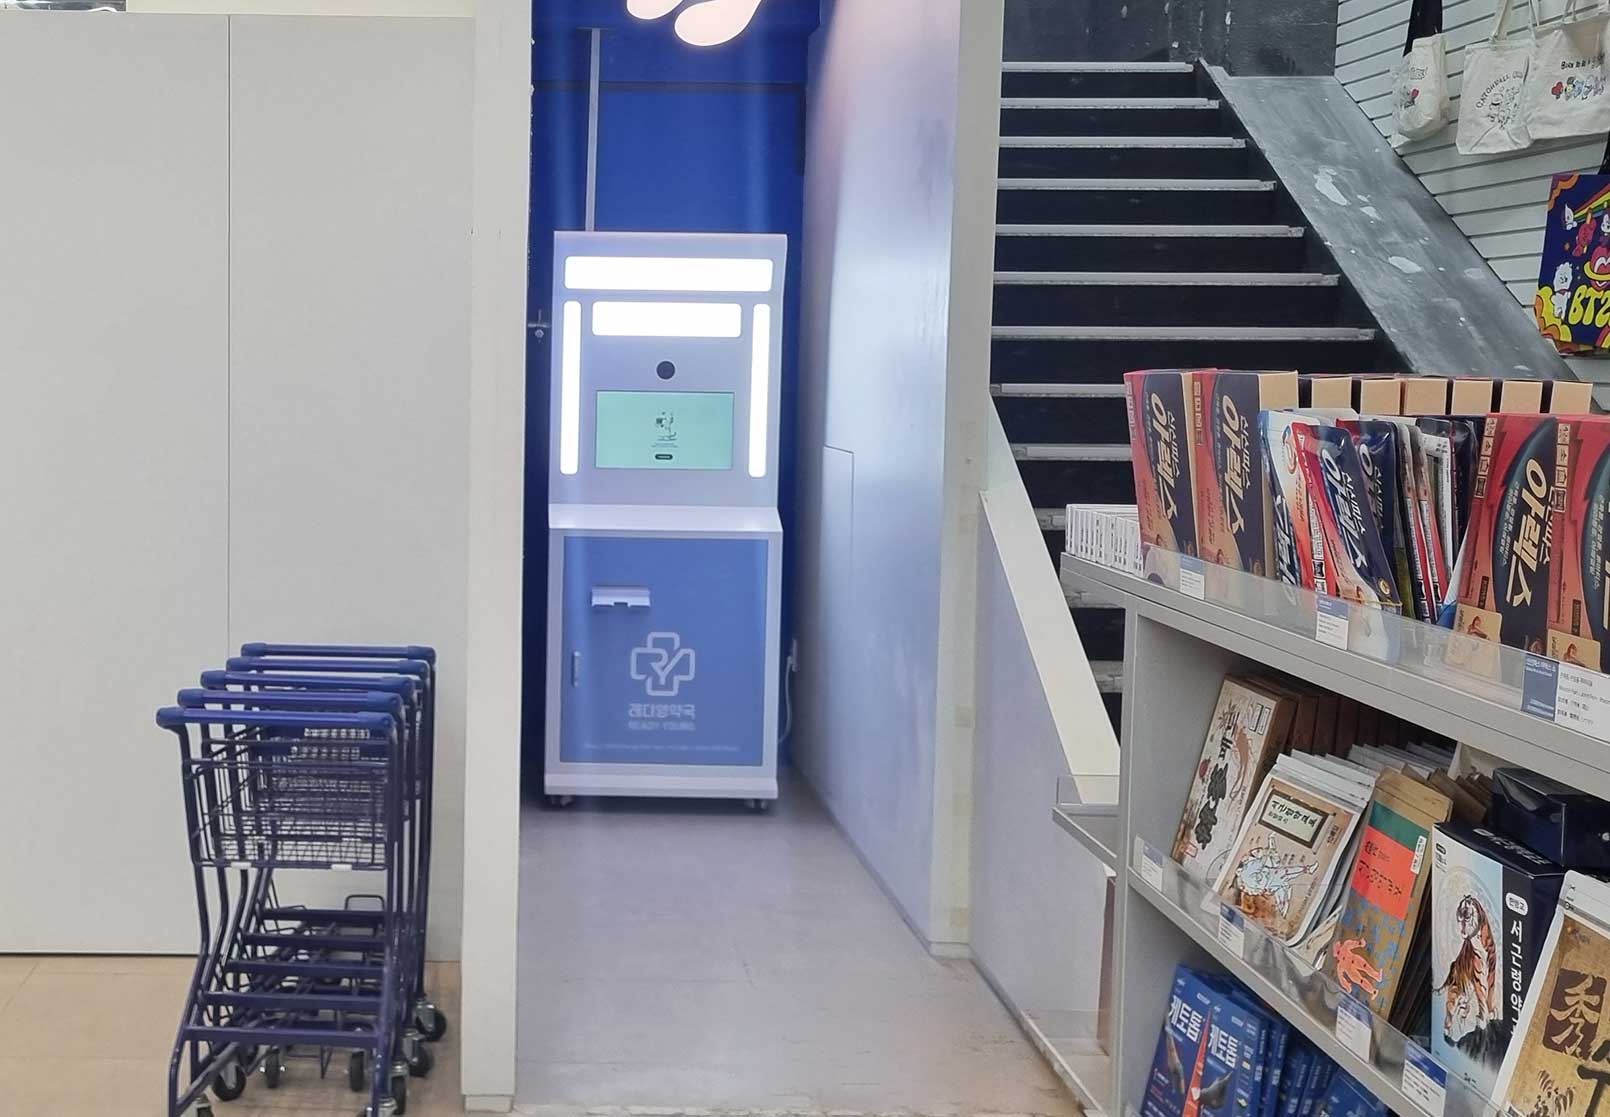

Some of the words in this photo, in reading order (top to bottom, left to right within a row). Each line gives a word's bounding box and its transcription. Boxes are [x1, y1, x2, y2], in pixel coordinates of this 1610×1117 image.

[1568, 284, 1610, 328] BT2
[1152, 393, 1178, 520] 아렉스
[1222, 395, 1245, 534] 아렉스
[1322, 449, 1368, 569] 아렉스
[1506, 459, 1547, 607] 아렉스
[1168, 995, 1203, 1042] 케토톱
[1208, 1024, 1239, 1069] 케토톱
